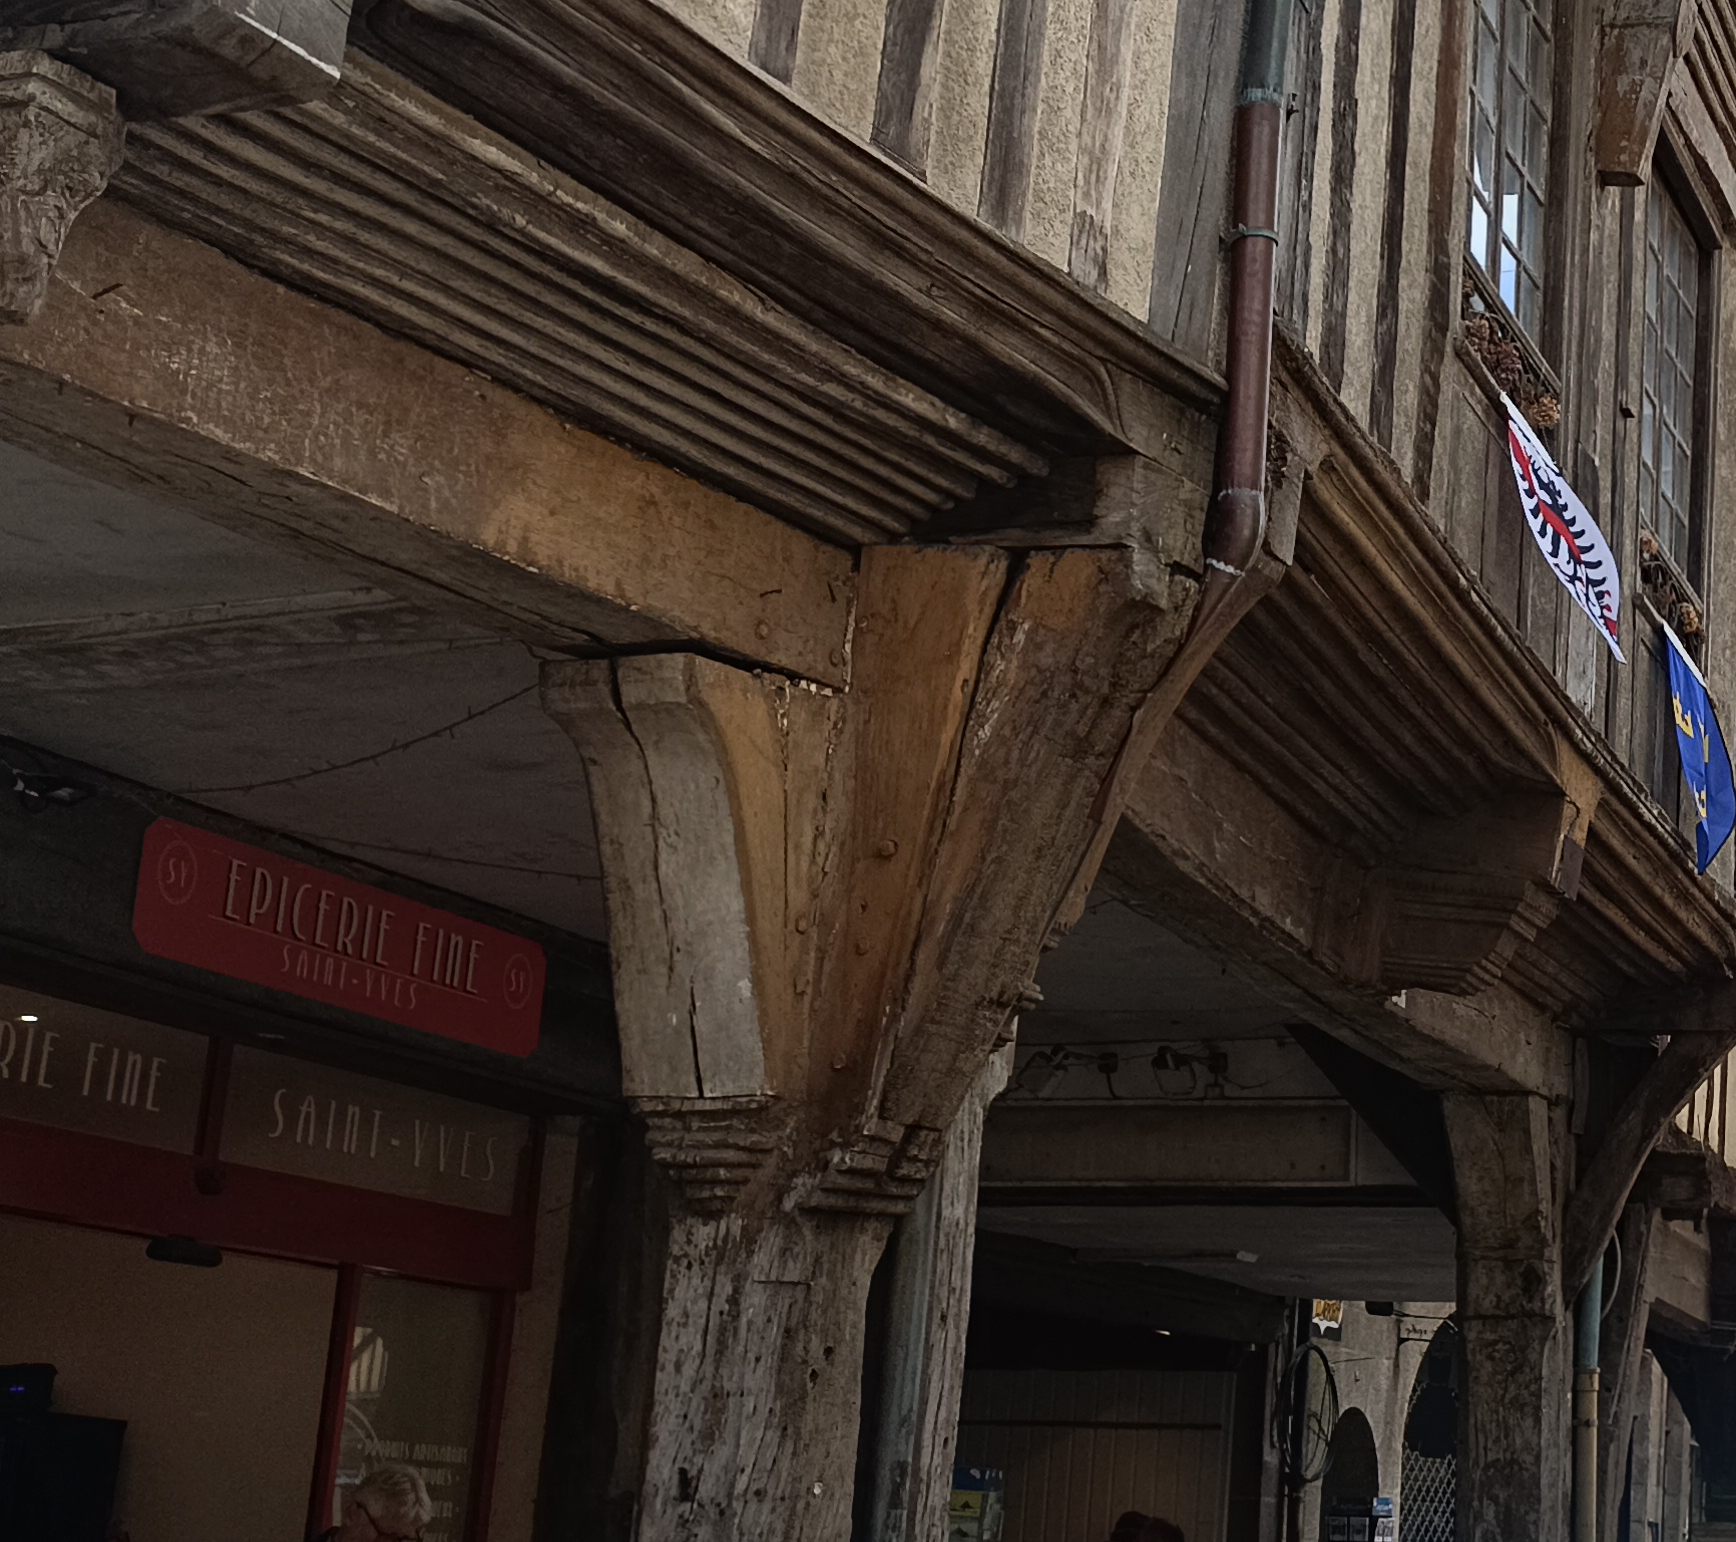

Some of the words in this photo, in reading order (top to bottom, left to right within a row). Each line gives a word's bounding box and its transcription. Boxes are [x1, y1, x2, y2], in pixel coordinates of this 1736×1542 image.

[223, 858, 395, 967] EPICERIE
[411, 921, 485, 995] FINE
[279, 943, 418, 1010] SAINT-YVES
[82, 1041, 168, 1112] FINE
[268, 1087, 498, 1182] SAINT-YVES
